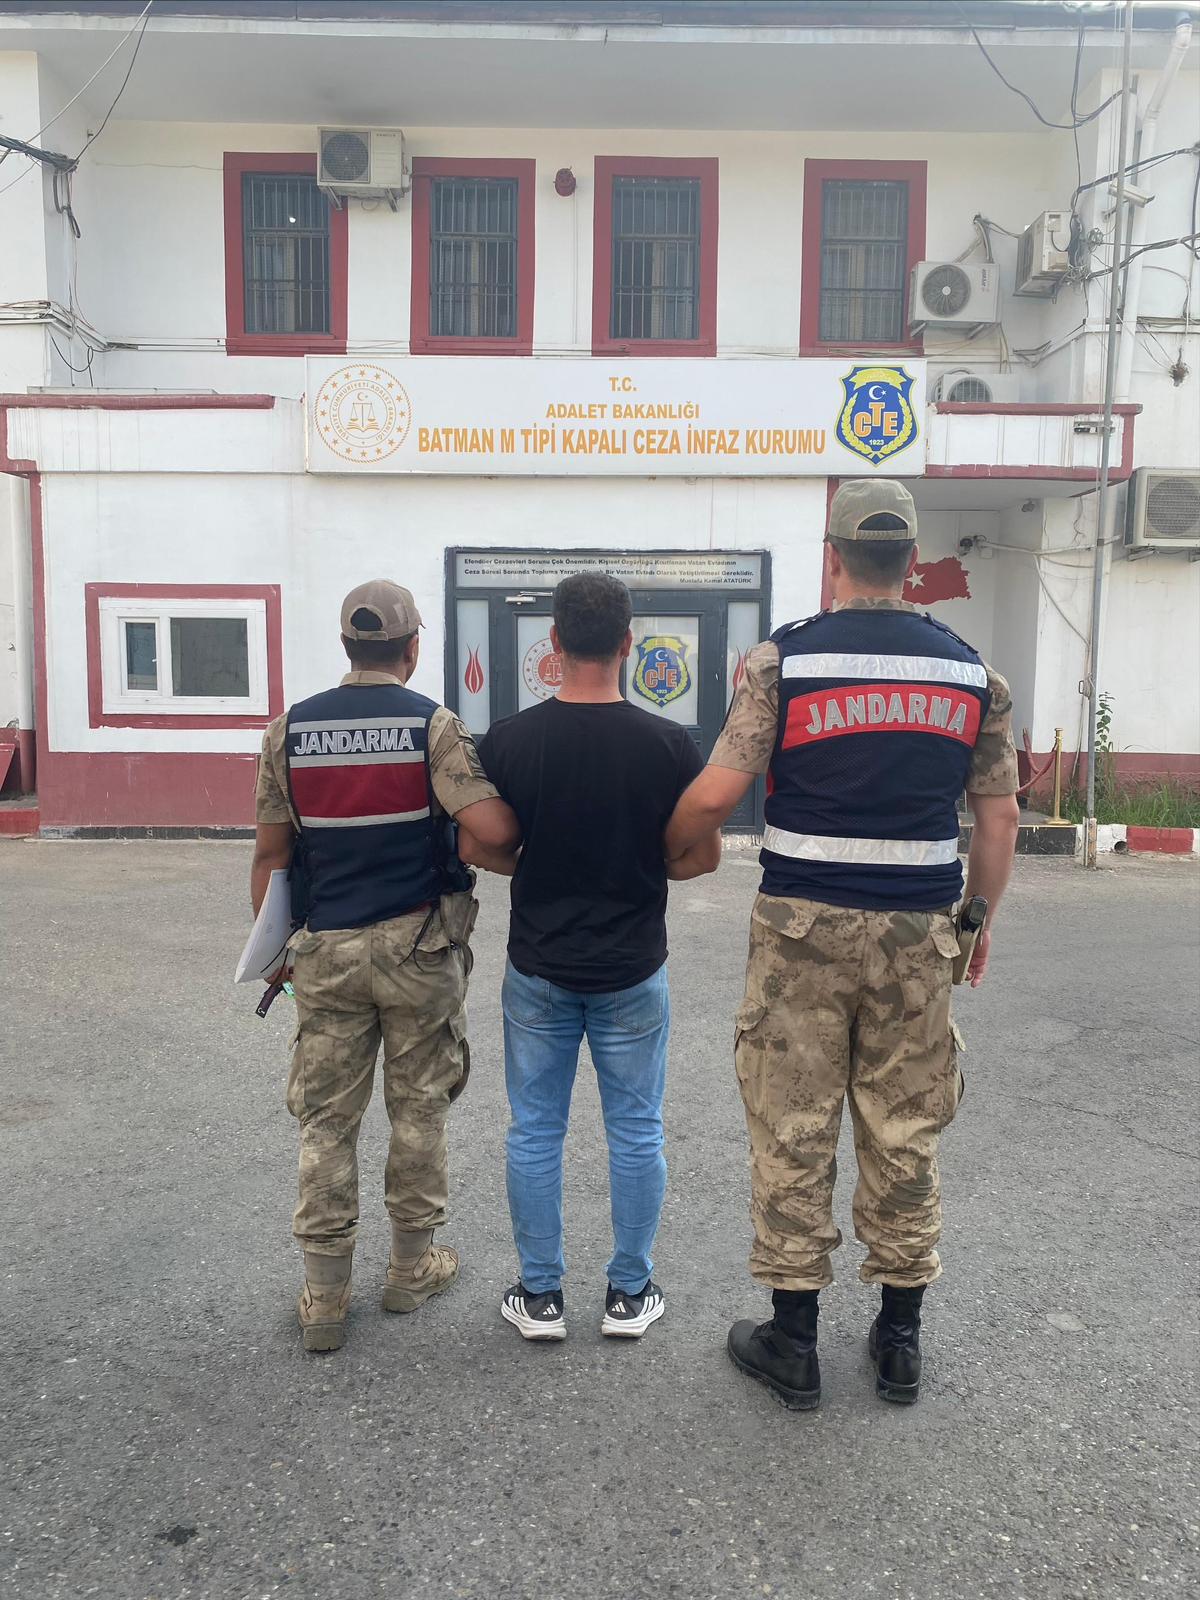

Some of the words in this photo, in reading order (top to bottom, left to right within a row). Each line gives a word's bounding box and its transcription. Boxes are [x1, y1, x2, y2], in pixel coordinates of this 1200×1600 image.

[609, 376, 637, 392] T.C.
[545, 403, 608, 419] ADALET
[612, 401, 700, 419] BAKANLIĞI
[853, 401, 898, 438] CTE
[418, 427, 494, 453] BATMAN
[500, 428, 515, 453] M
[520, 422, 556, 454] TİPİ
[562, 428, 627, 454] KAPALI
[633, 428, 681, 455] CEZA
[687, 423, 740, 455] İNFAZ
[745, 429, 826, 455] KURUMU
[644, 661, 678, 688] CTE
[805, 693, 967, 735] JANDARMA
[294, 728, 415, 755] JANDARMA
